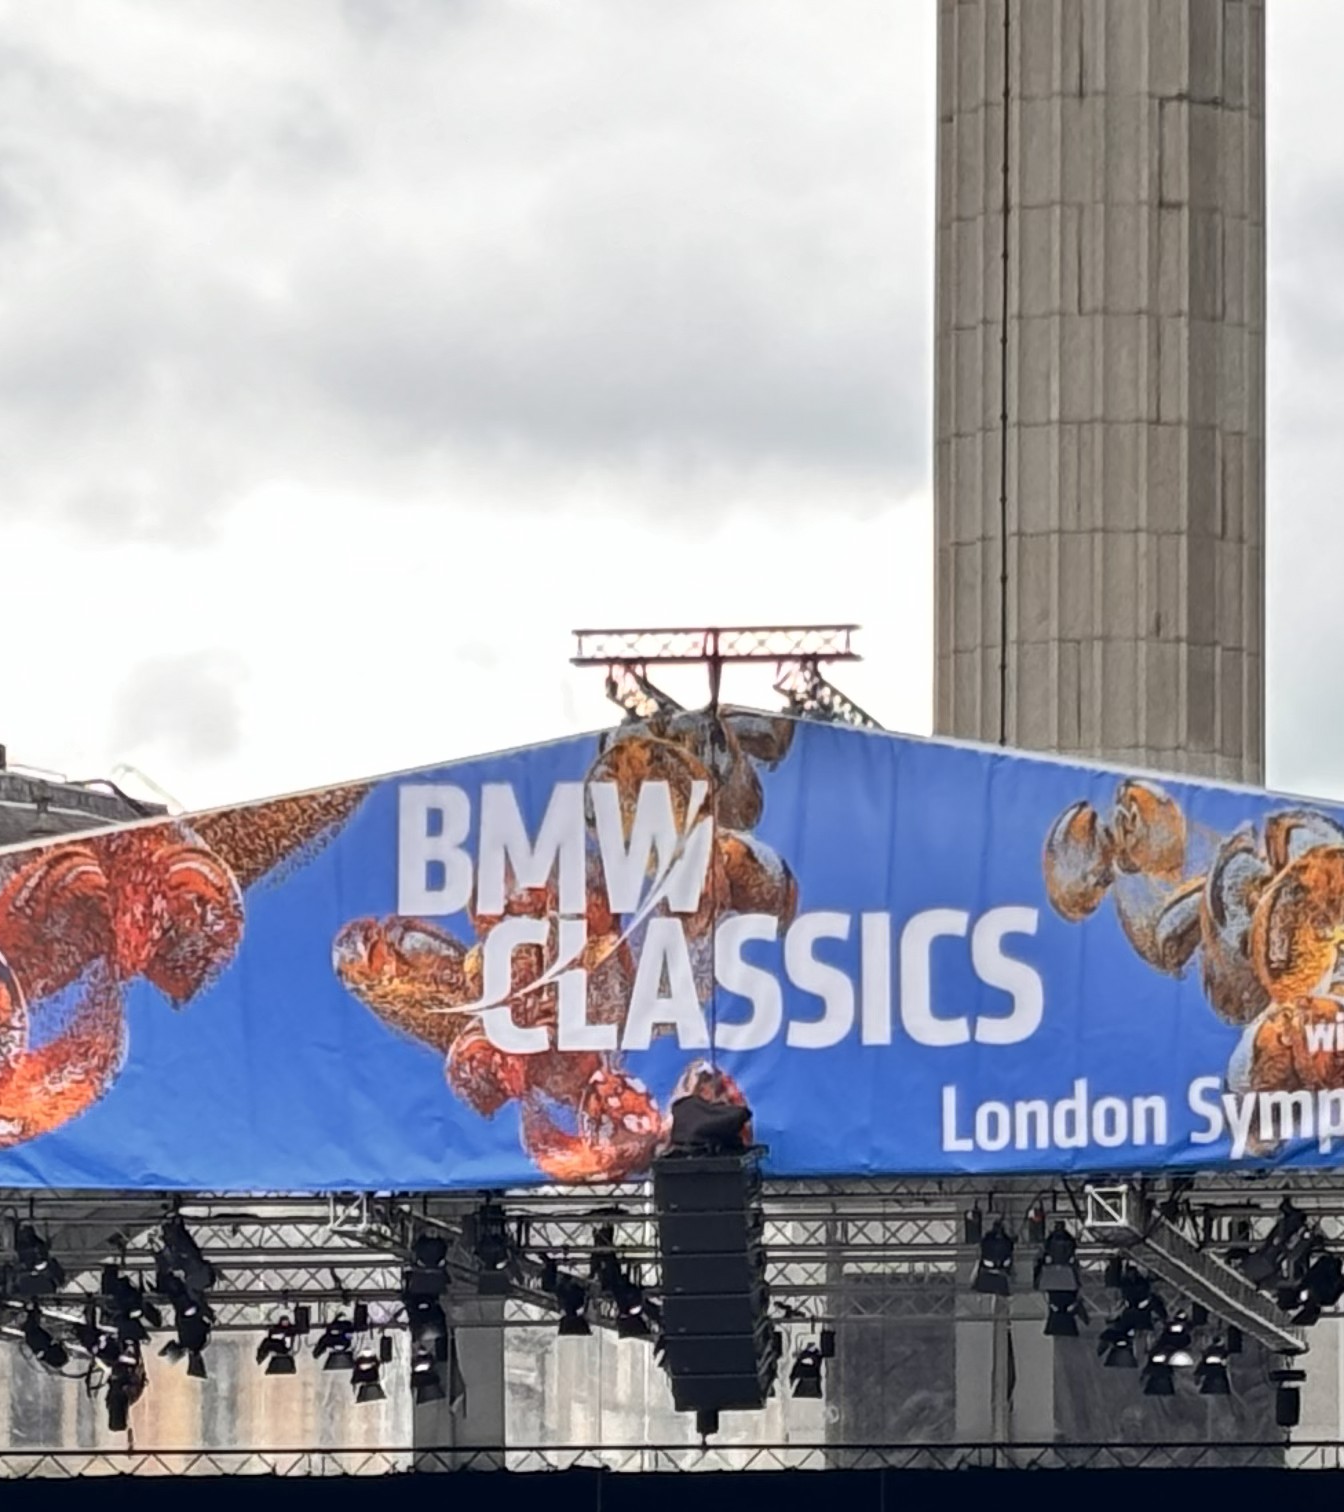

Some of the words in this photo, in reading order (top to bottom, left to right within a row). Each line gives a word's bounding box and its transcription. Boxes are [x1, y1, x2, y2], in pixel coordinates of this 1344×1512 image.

[396, 779, 715, 917] BMW
[481, 906, 1045, 1055] CLASSICS
[942, 1076, 1168, 1152] London
